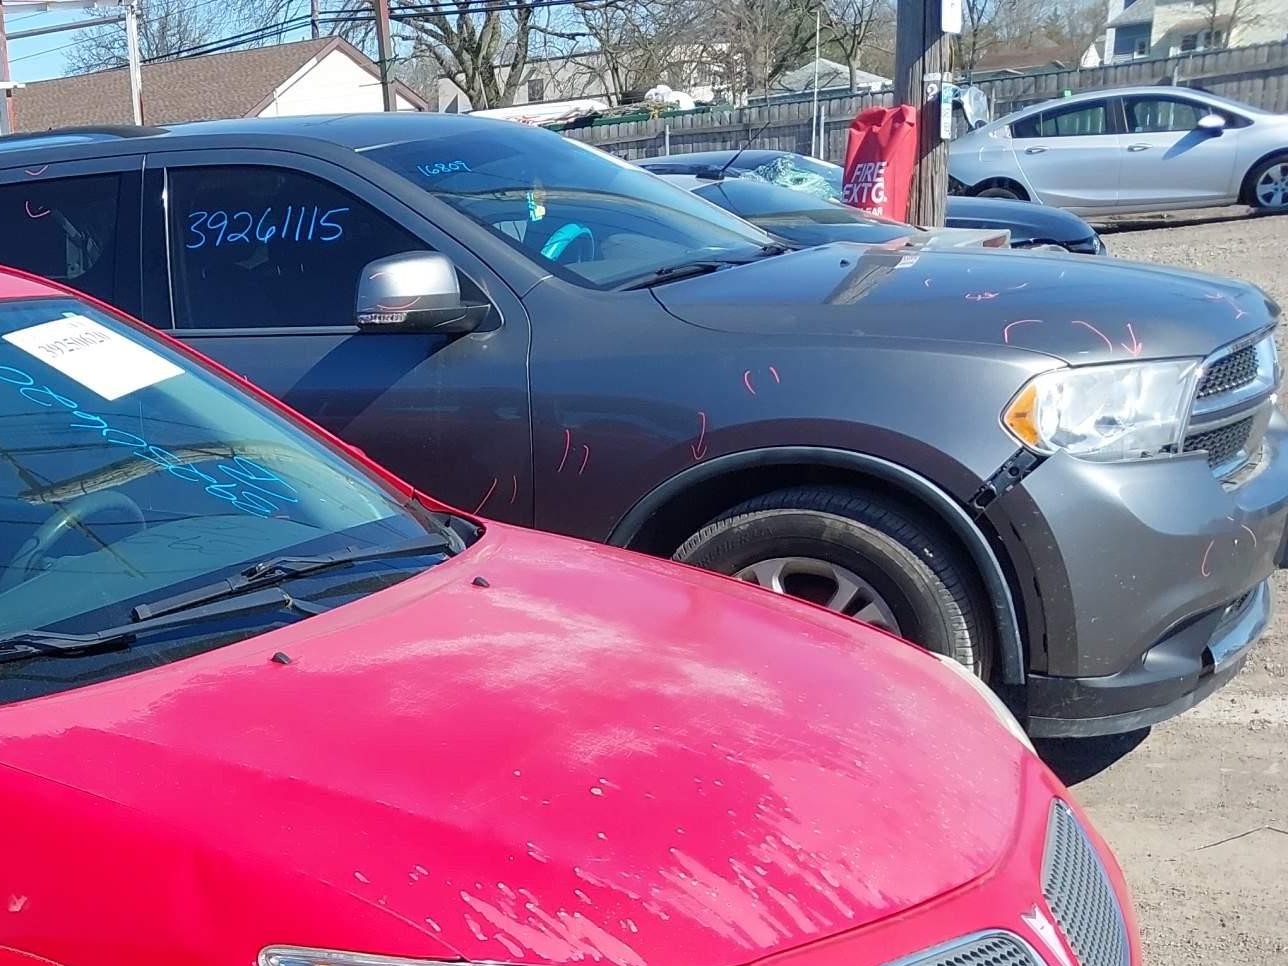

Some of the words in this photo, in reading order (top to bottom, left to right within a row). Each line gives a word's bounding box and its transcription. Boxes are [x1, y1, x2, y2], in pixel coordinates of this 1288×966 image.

[417, 160, 472, 176] 16809
[851, 161, 887, 182] FIRE
[186, 205, 350, 248] 39261115
